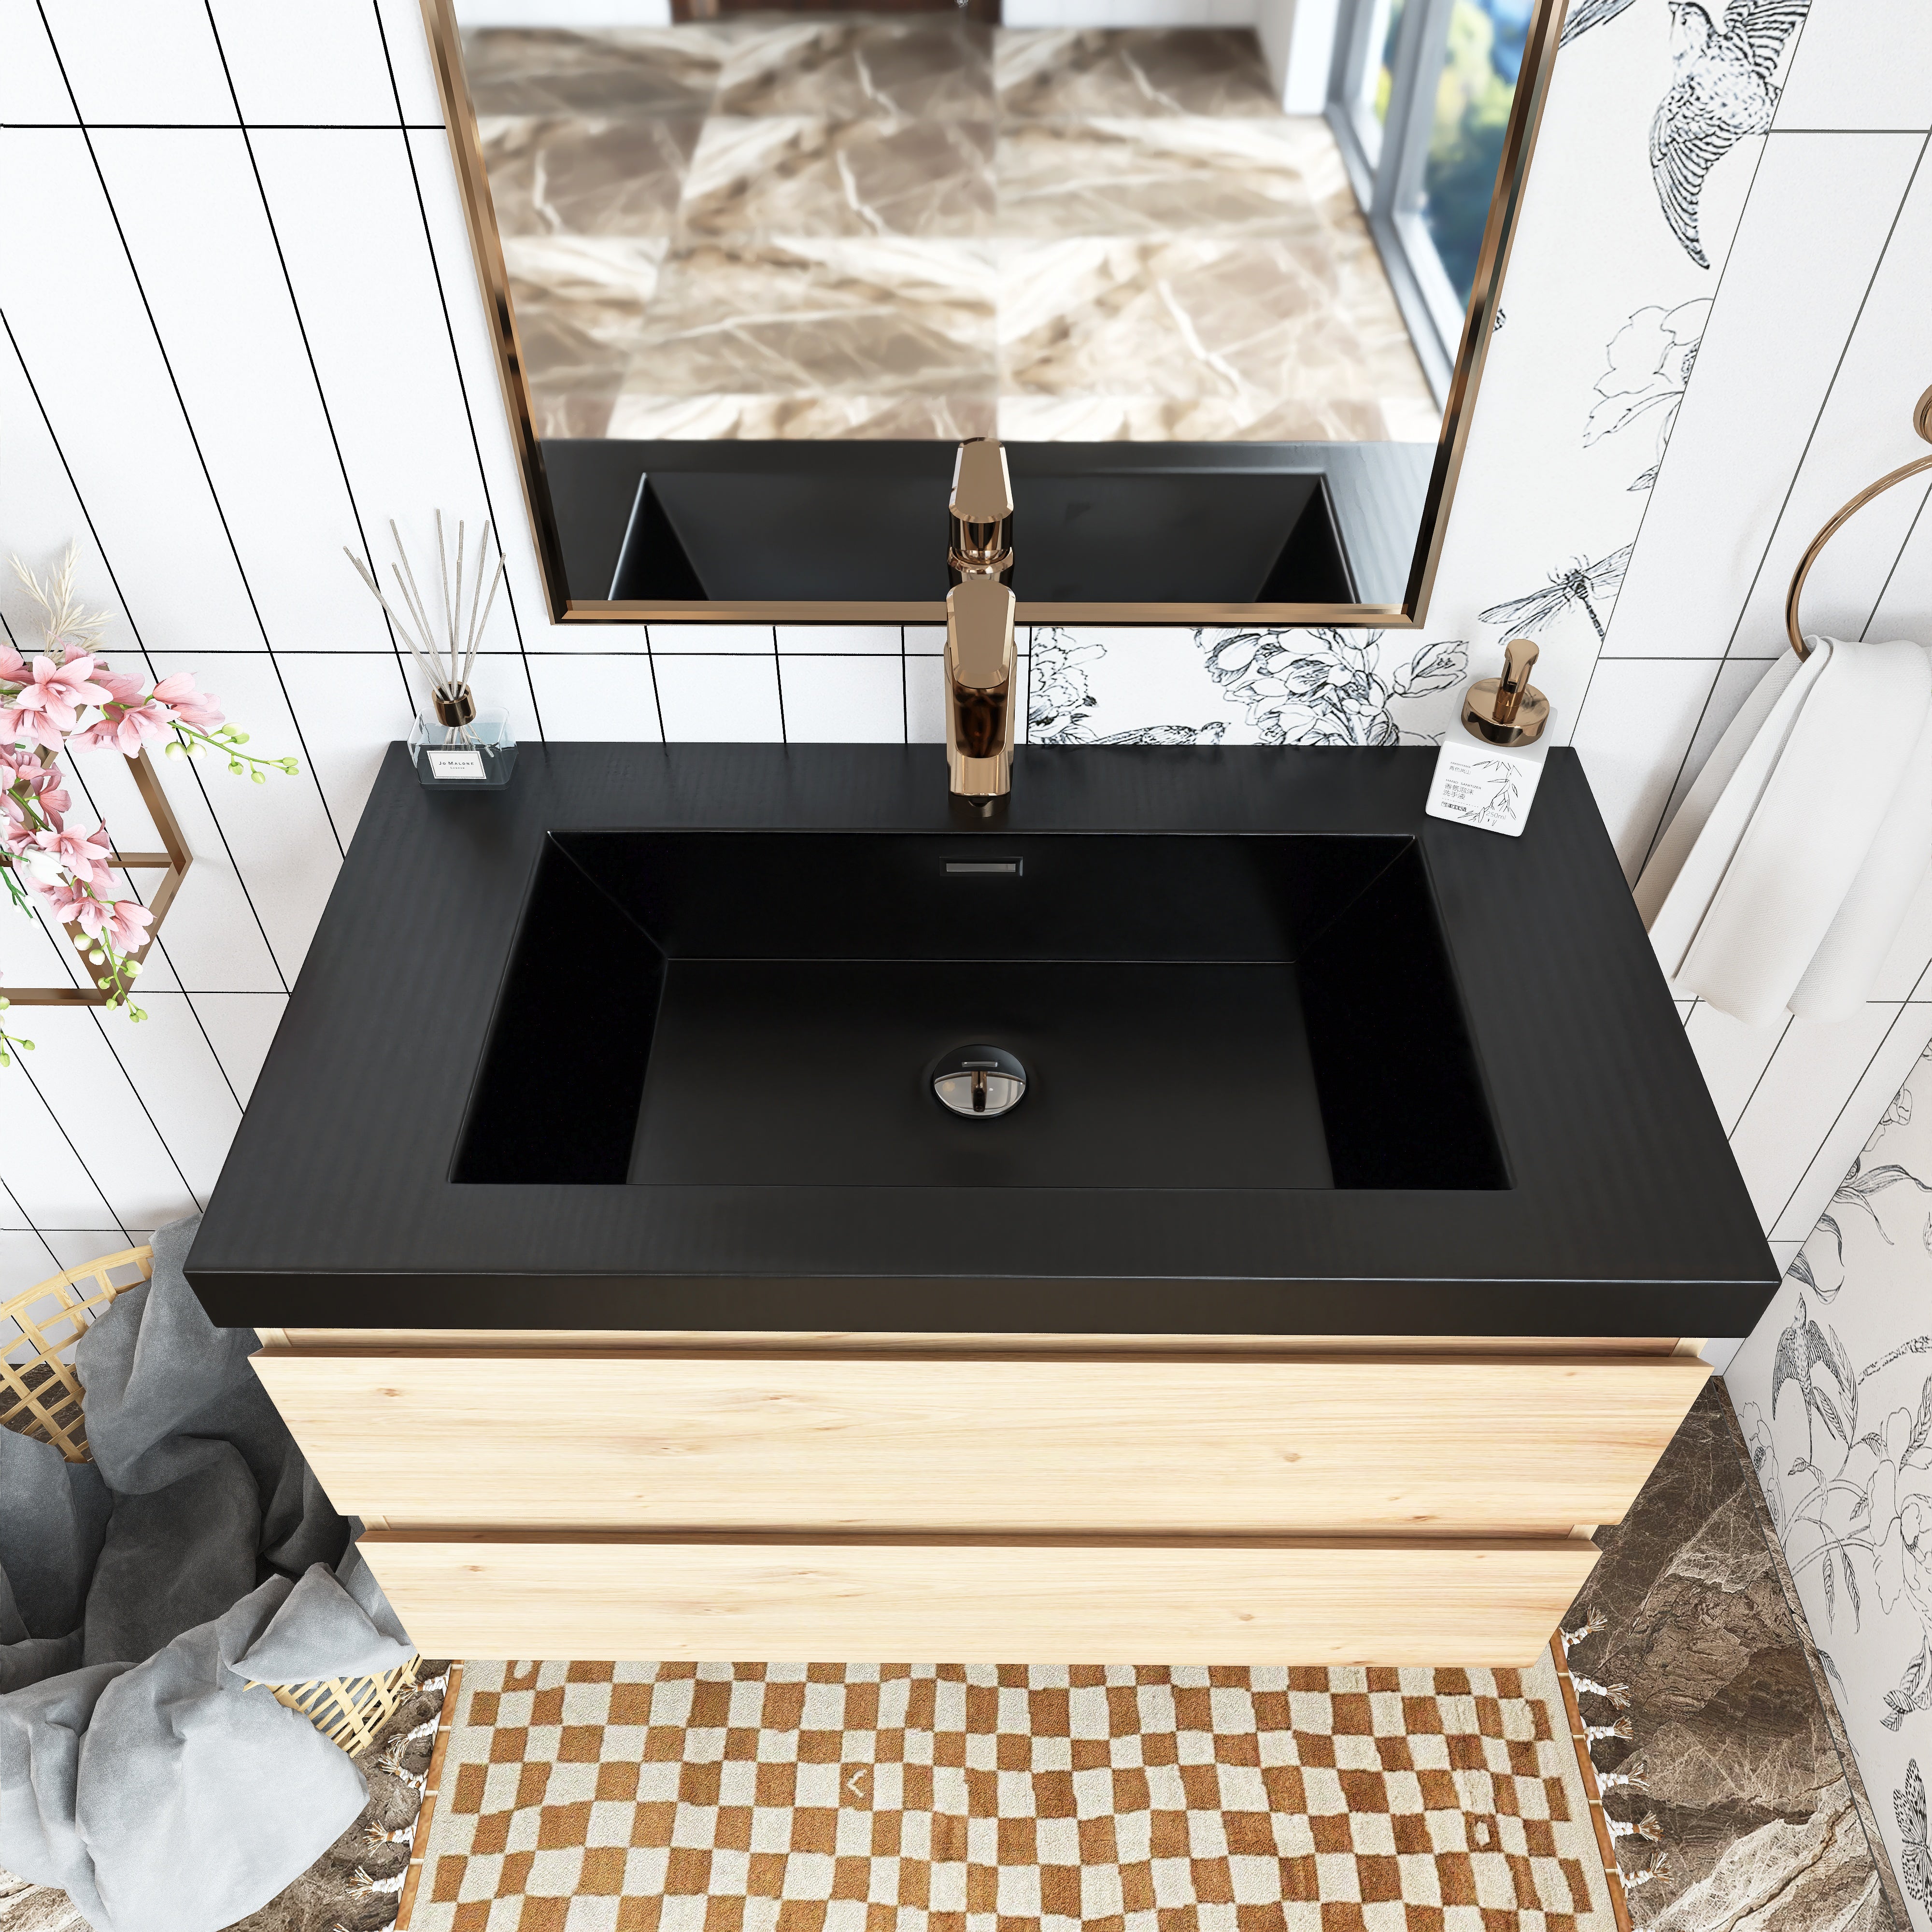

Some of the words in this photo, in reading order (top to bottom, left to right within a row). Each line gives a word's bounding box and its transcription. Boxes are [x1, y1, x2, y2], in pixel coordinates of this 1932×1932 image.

[1443, 789, 1465, 799] 洗手液
[1445, 783, 1475, 795] 香氛泡沫
[1486, 811, 1506, 820] 250ml
